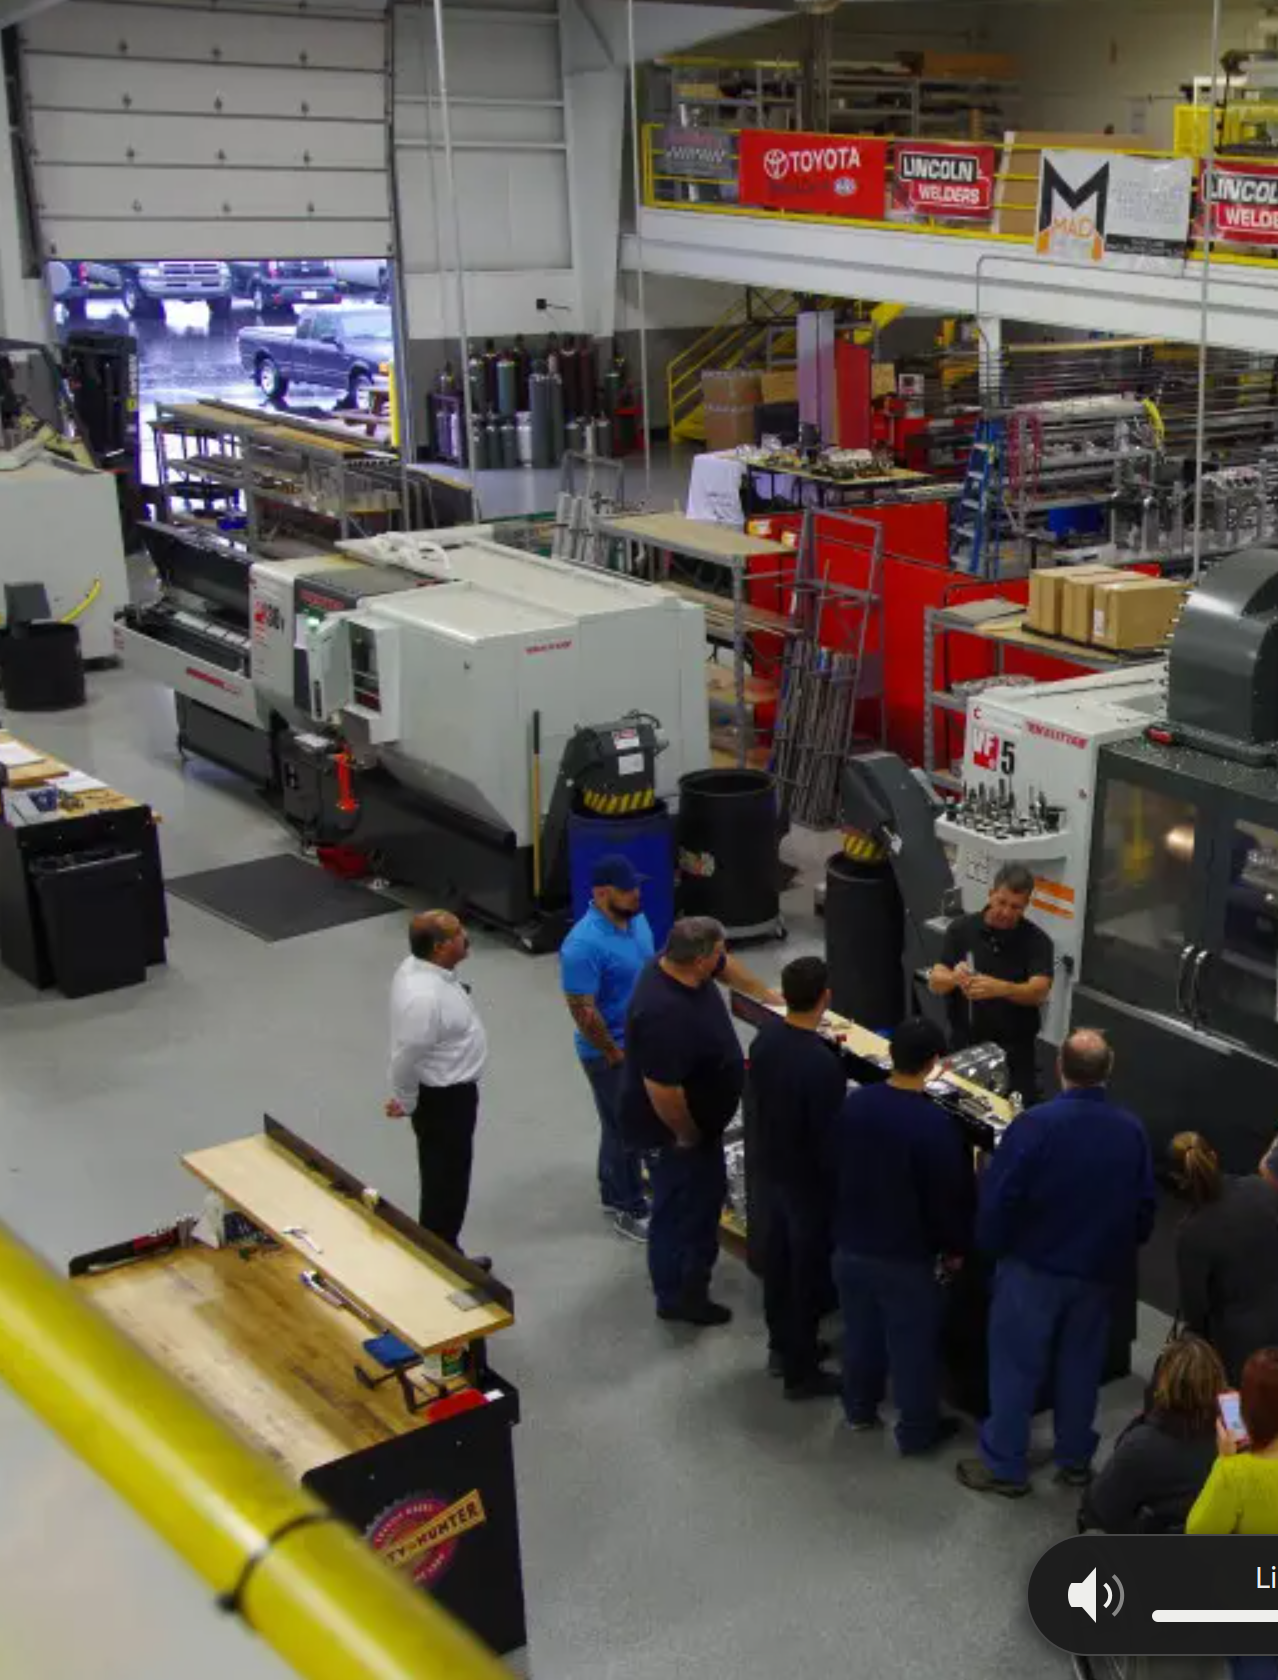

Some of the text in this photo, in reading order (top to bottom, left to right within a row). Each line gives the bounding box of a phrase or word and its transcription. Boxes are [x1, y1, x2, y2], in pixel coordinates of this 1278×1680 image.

[789, 147, 861, 173] TOYOTA
[903, 156, 974, 182] LINCOLN
[919, 183, 980, 205] WELDERS
